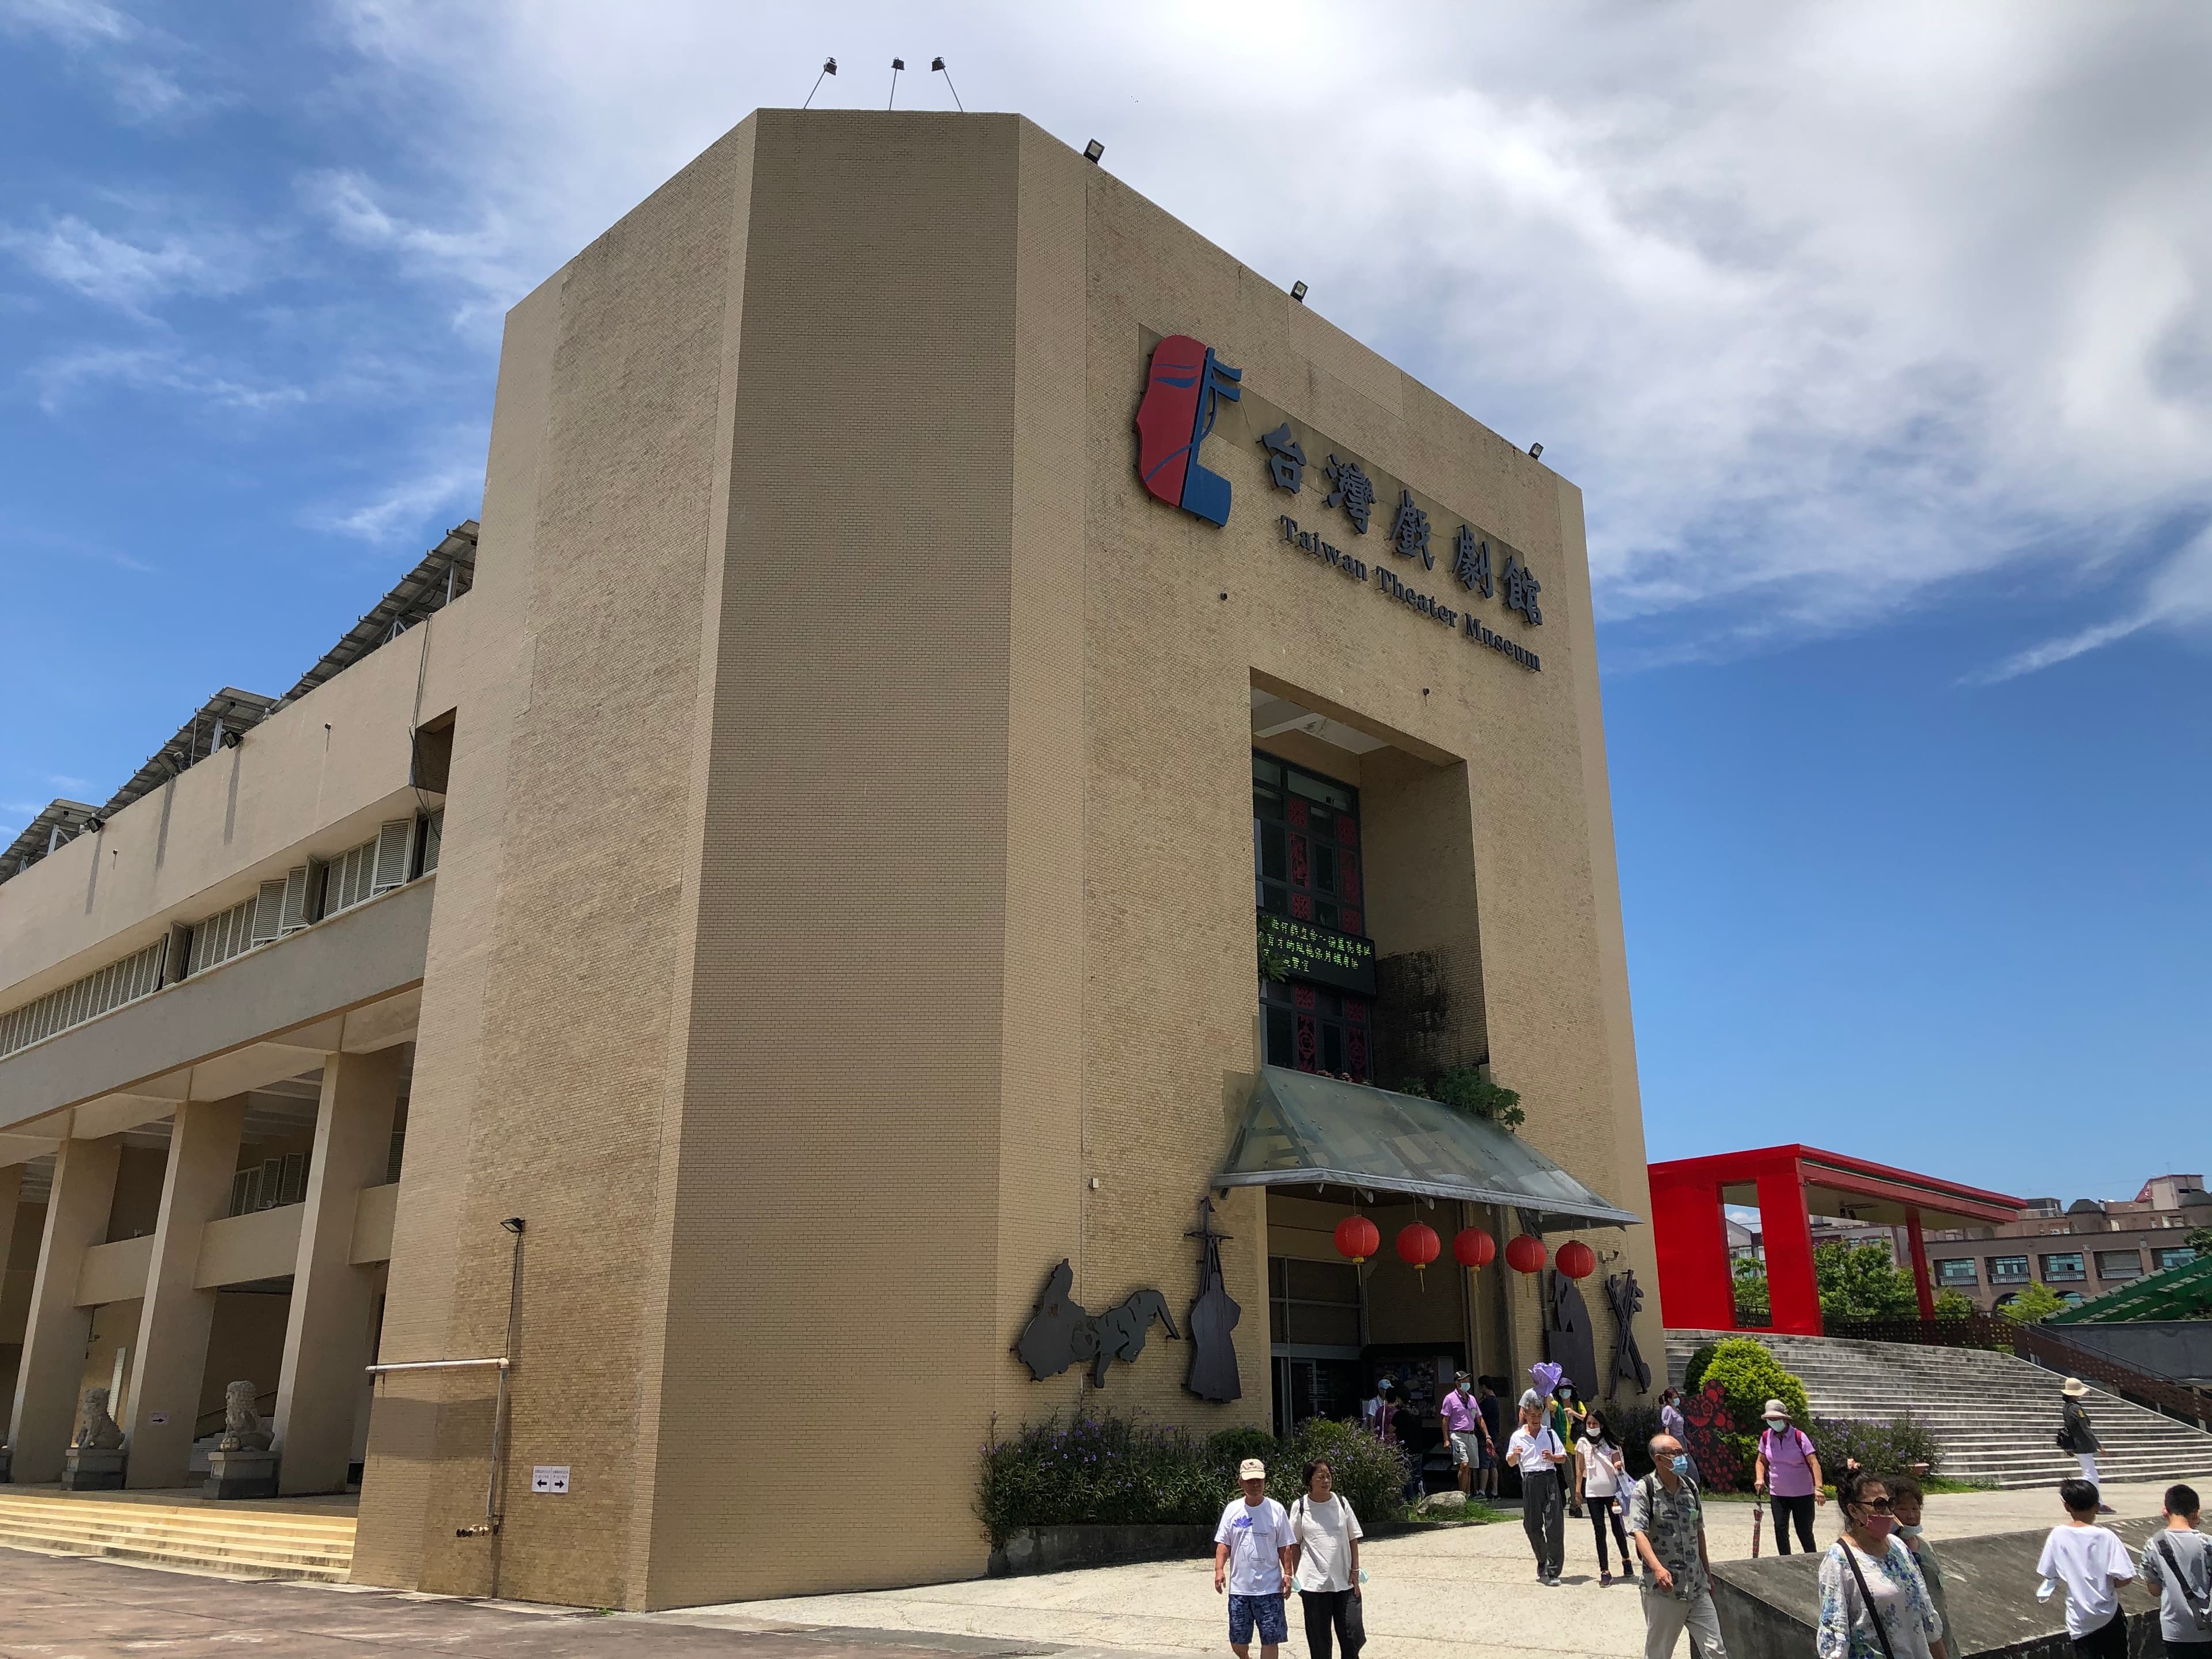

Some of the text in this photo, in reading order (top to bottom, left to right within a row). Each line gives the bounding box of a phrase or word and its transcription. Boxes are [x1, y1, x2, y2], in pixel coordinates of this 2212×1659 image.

[1260, 422, 1543, 626] 台灣戲劇館
[1280, 515, 1541, 672] Taiwan Theater Museum
